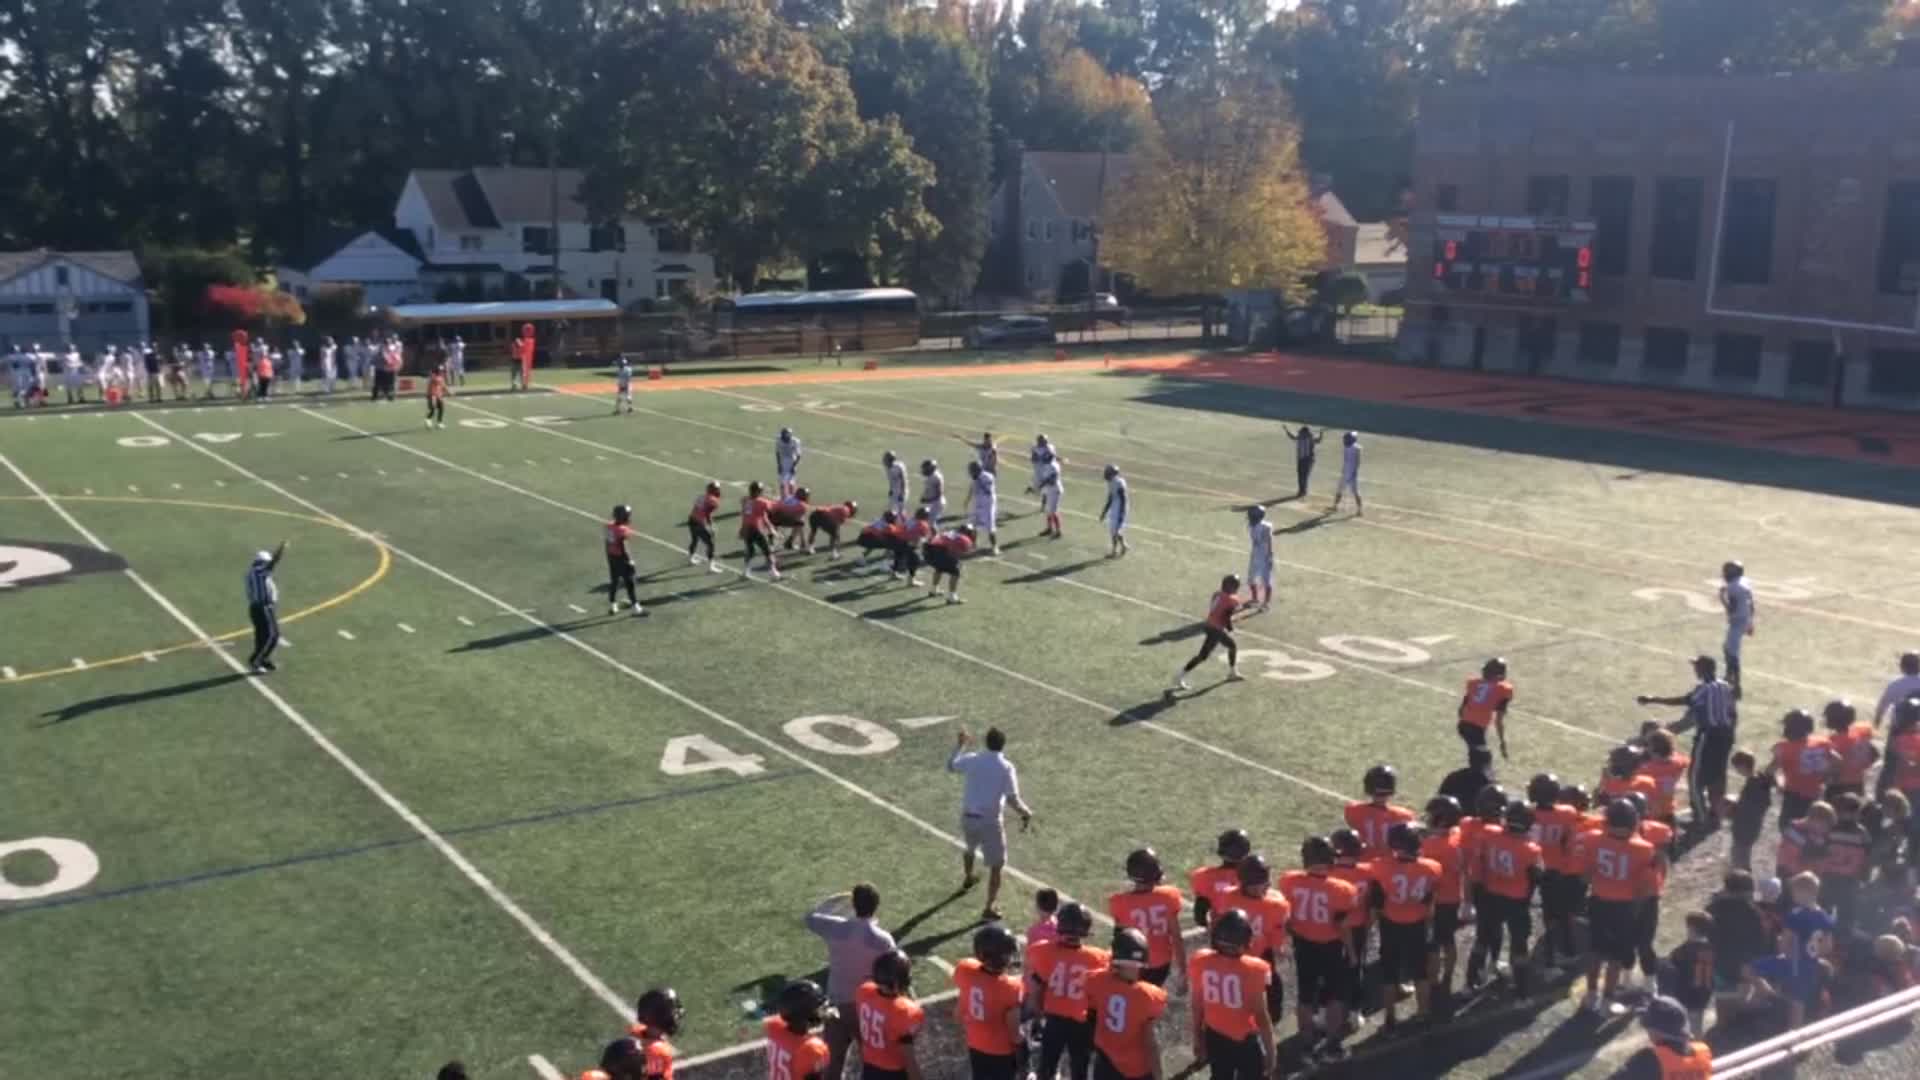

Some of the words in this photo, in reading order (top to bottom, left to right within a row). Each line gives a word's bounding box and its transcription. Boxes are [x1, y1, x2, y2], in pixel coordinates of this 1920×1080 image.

[1221, 634, 1431, 681] 30
[659, 715, 899, 777] 40
[1597, 848, 1630, 880] 51
[1294, 888, 1329, 923] 76
[1391, 874, 1428, 904] 34
[1049, 961, 1088, 998] 42
[1202, 970, 1242, 1008] 60
[969, 986, 985, 1020] 6
[1107, 994, 1127, 1033] 9
[859, 1004, 887, 1049] 65
